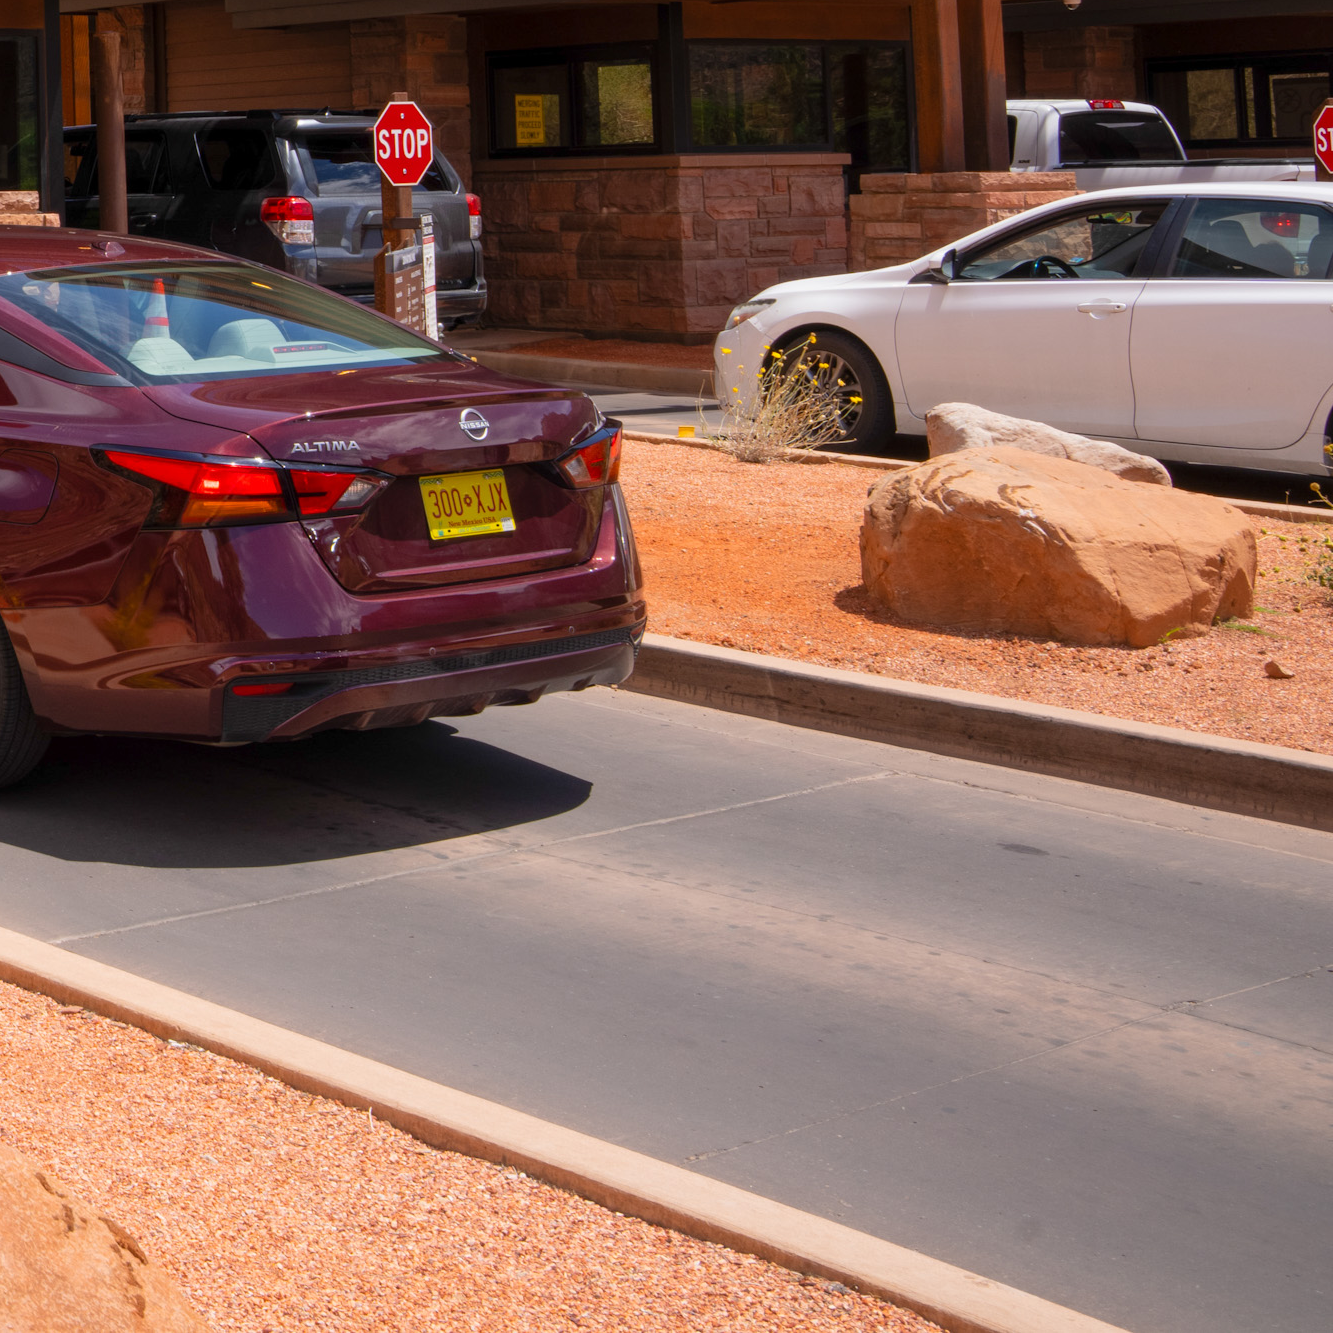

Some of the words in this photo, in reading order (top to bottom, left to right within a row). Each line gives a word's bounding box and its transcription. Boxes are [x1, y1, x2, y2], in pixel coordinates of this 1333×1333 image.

[378, 127, 429, 160] STOP
[1317, 127, 1333, 152] ST
[459, 421, 490, 430] NISSAN
[291, 440, 361, 454] ALTIMA
[428, 487, 464, 519] 300
[471, 482, 508, 514] XJX
[461, 518, 483, 526] Mexico
